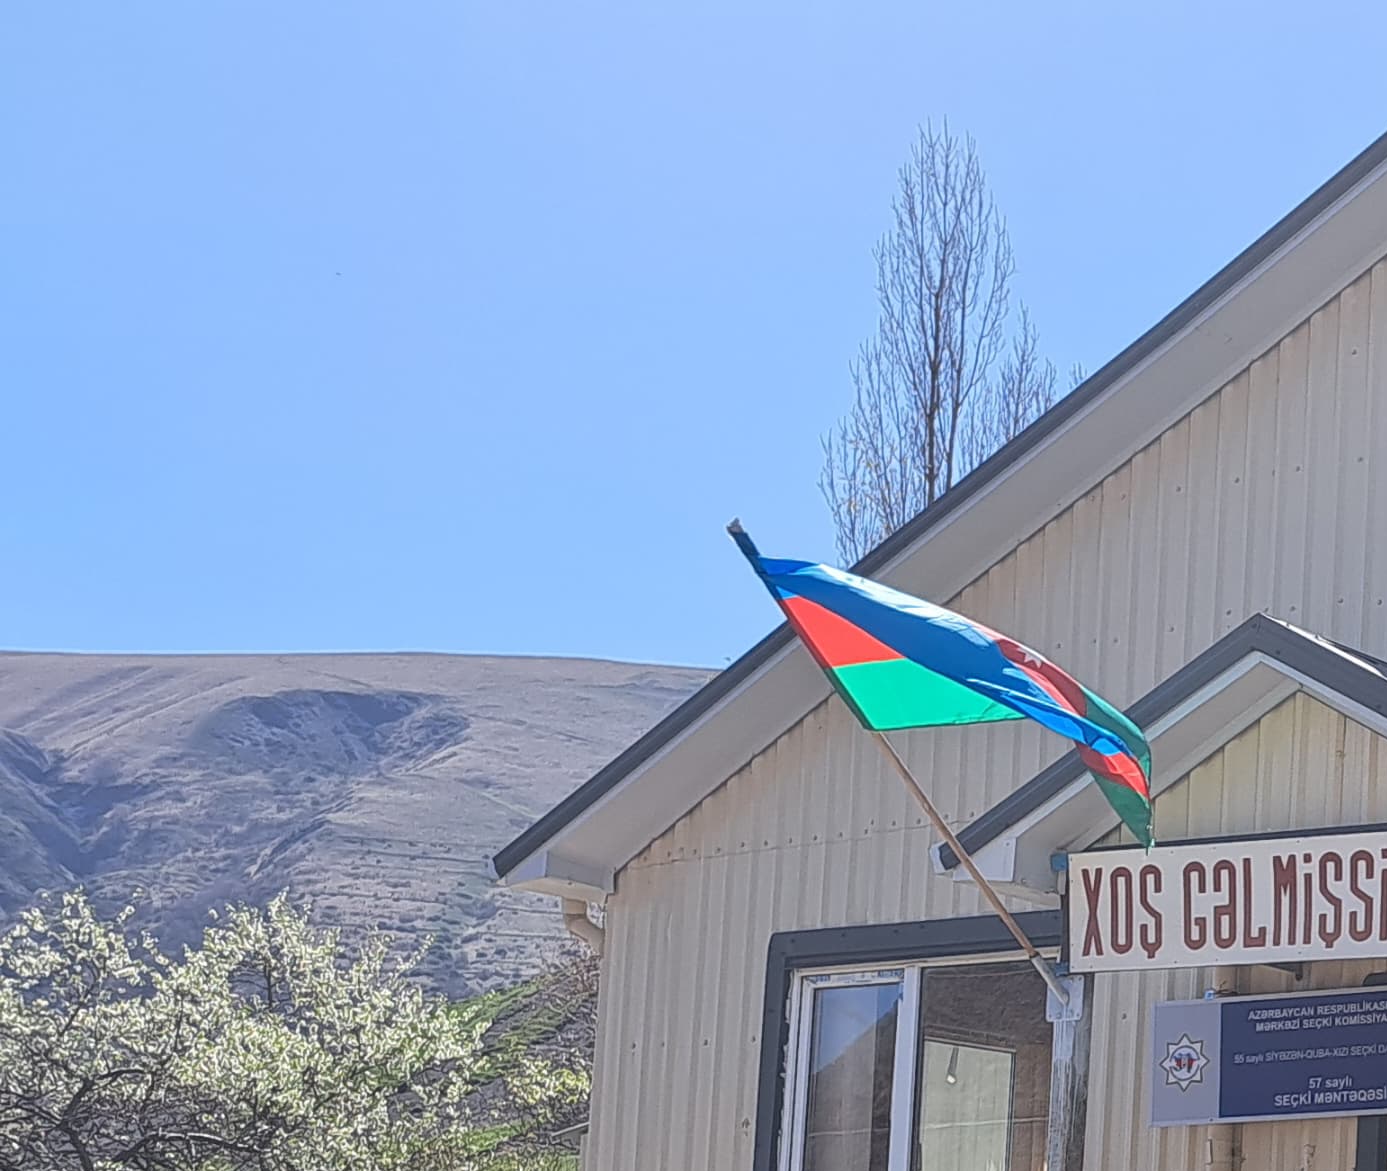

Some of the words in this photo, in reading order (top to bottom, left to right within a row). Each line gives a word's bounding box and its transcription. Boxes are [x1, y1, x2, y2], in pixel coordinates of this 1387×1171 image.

[1081, 863, 1163, 959] XOŞ
[1248, 1006, 1315, 1021] AZƏRBAYCAN
[1256, 1019, 1300, 1032] MƏRKƏZİ
[1303, 1015, 1333, 1030] SEÇKİ
[1350, 1045, 1377, 1057] SEÇKİ
[1309, 1078, 1323, 1089] 57
[1325, 1077, 1352, 1090] saylı
[1274, 1091, 1313, 1108] SEÇKİ
[1314, 1087, 1387, 1104] MƏNTƏQƏSİ
